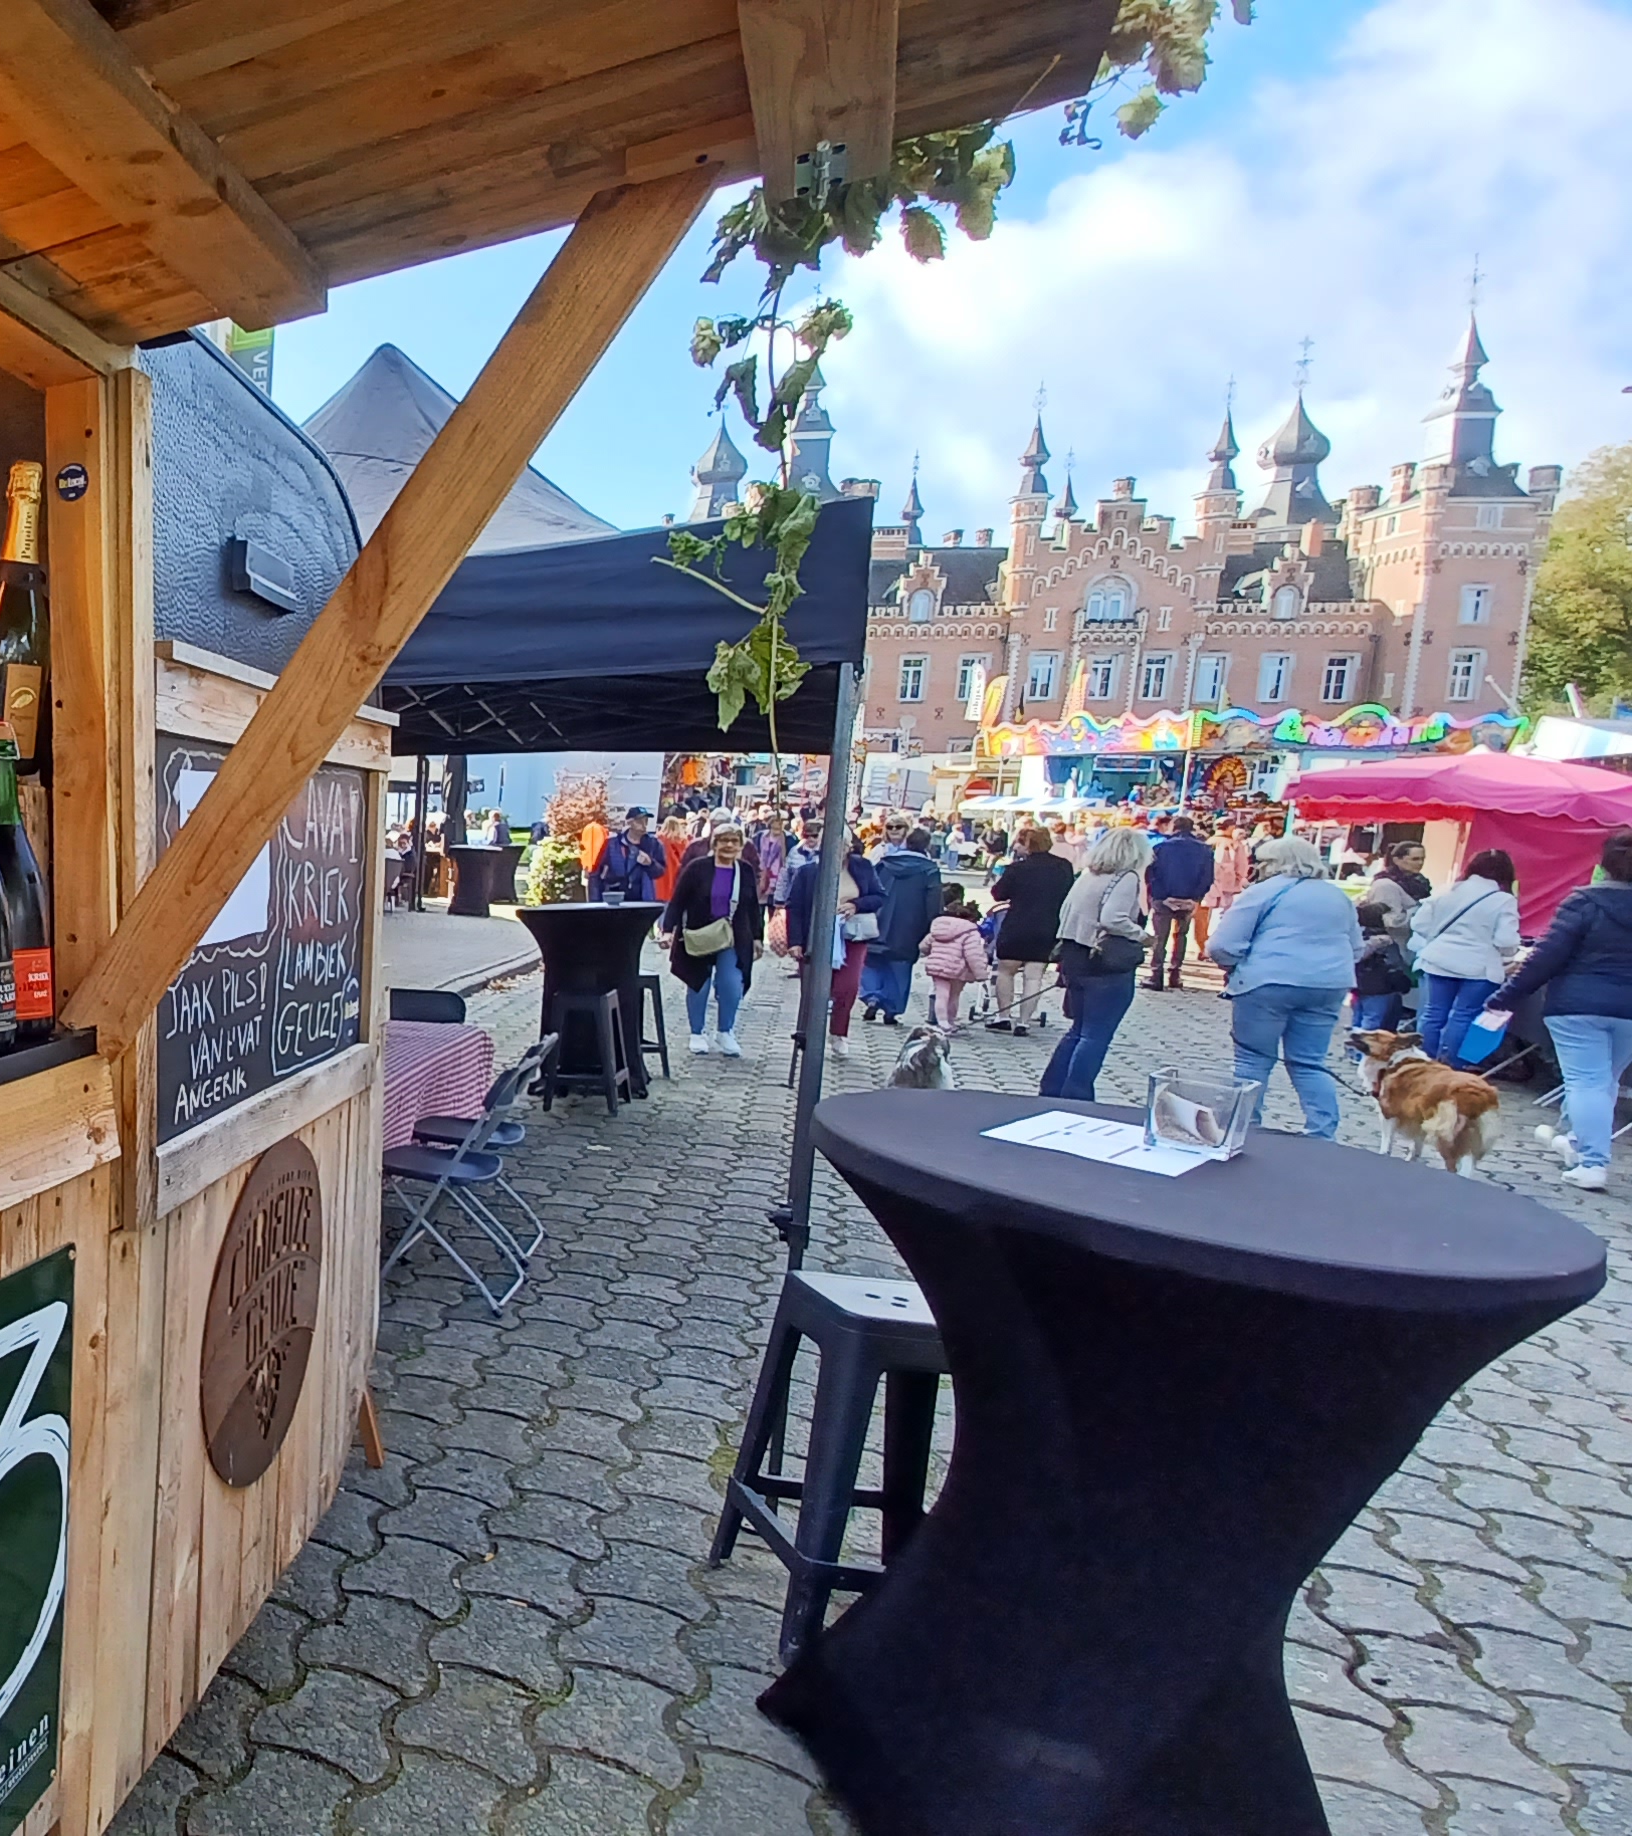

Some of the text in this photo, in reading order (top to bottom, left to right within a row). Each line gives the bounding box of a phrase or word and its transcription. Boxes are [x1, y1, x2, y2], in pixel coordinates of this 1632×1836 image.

[288, 859, 349, 929] KRIEK
[283, 932, 347, 990] LAMBIEK
[191, 1027, 223, 1080] VAN
[278, 991, 342, 1056] GEUZE
